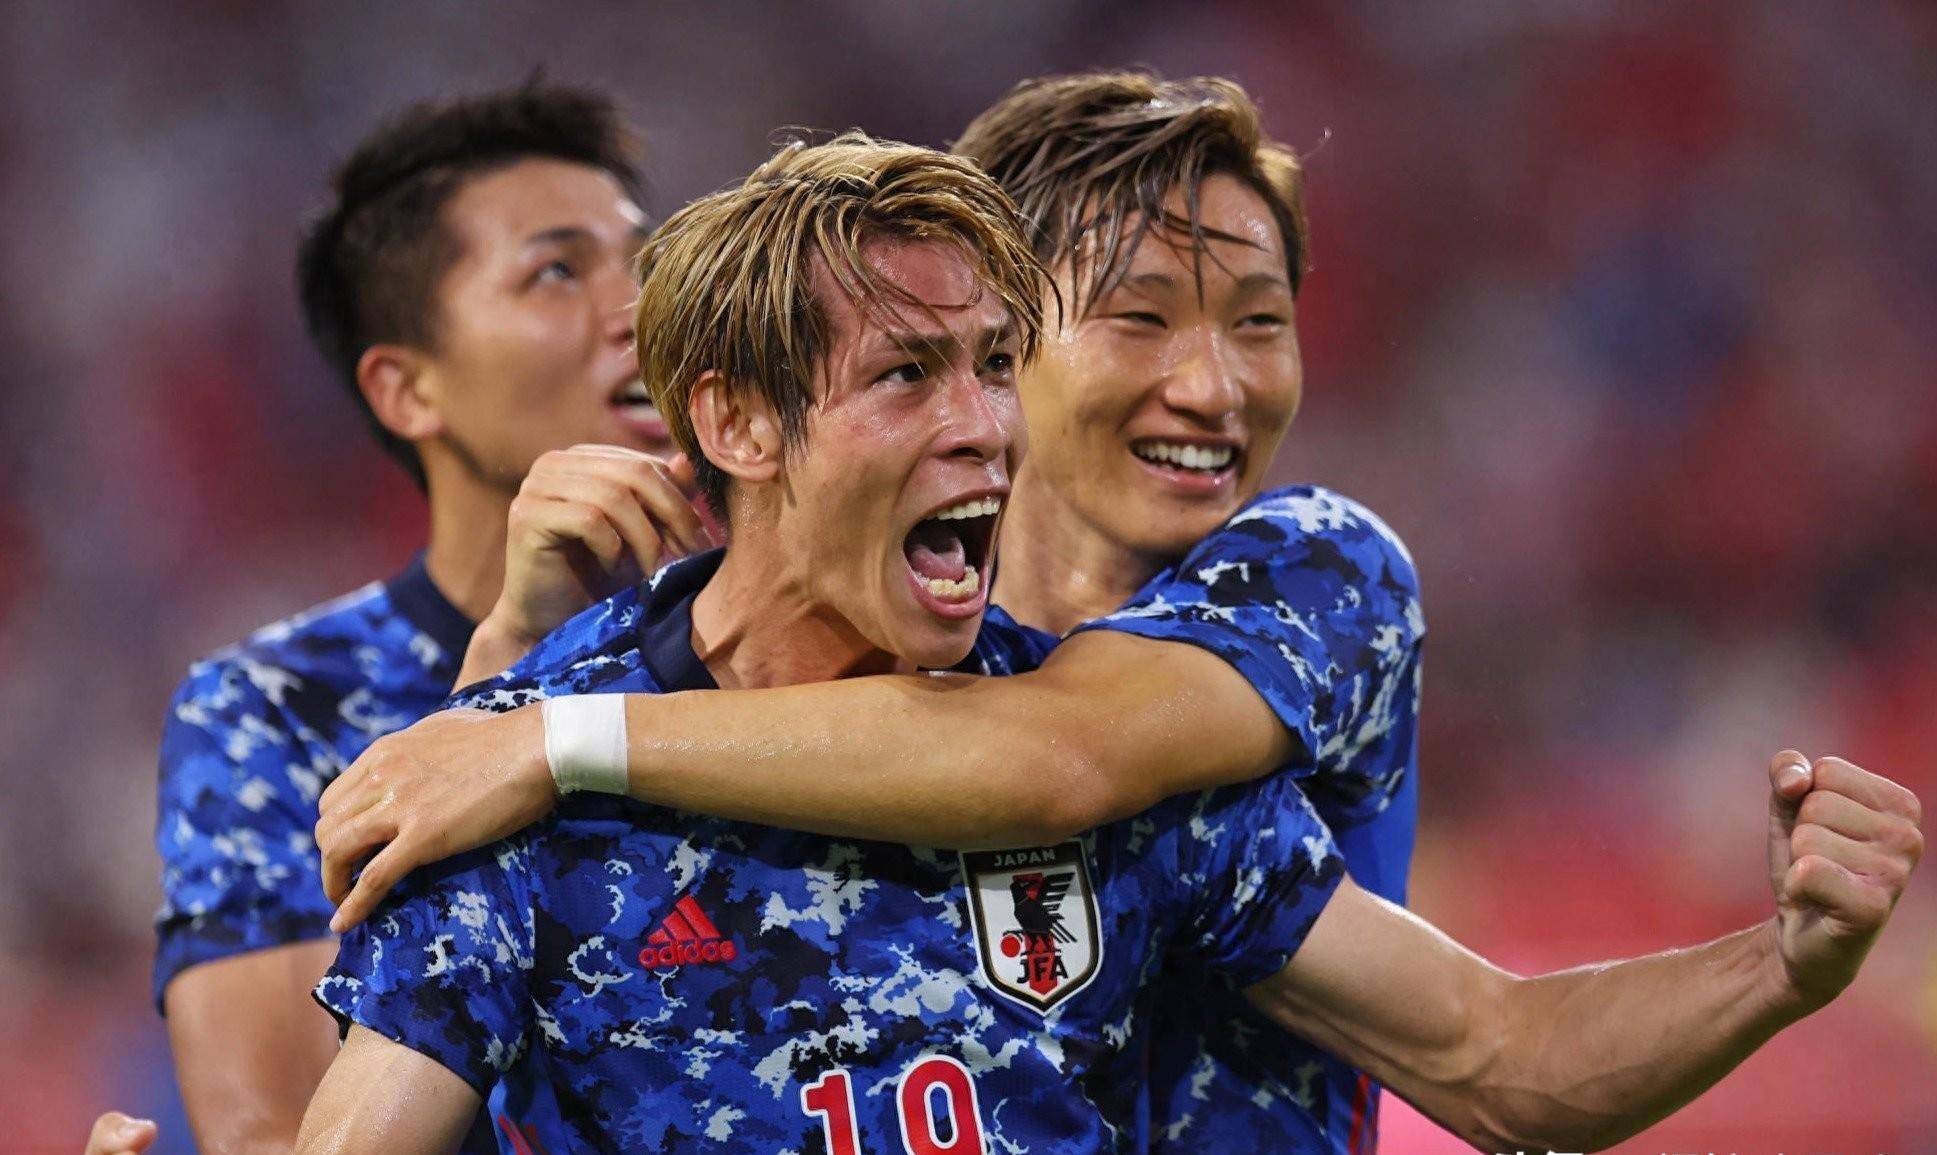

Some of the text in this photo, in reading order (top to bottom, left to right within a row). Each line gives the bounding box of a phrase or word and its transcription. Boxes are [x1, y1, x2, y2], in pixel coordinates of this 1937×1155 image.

[994, 848, 1056, 867] JAPAN
[639, 940, 735, 969] adidas
[1017, 955, 1069, 984] JFA
